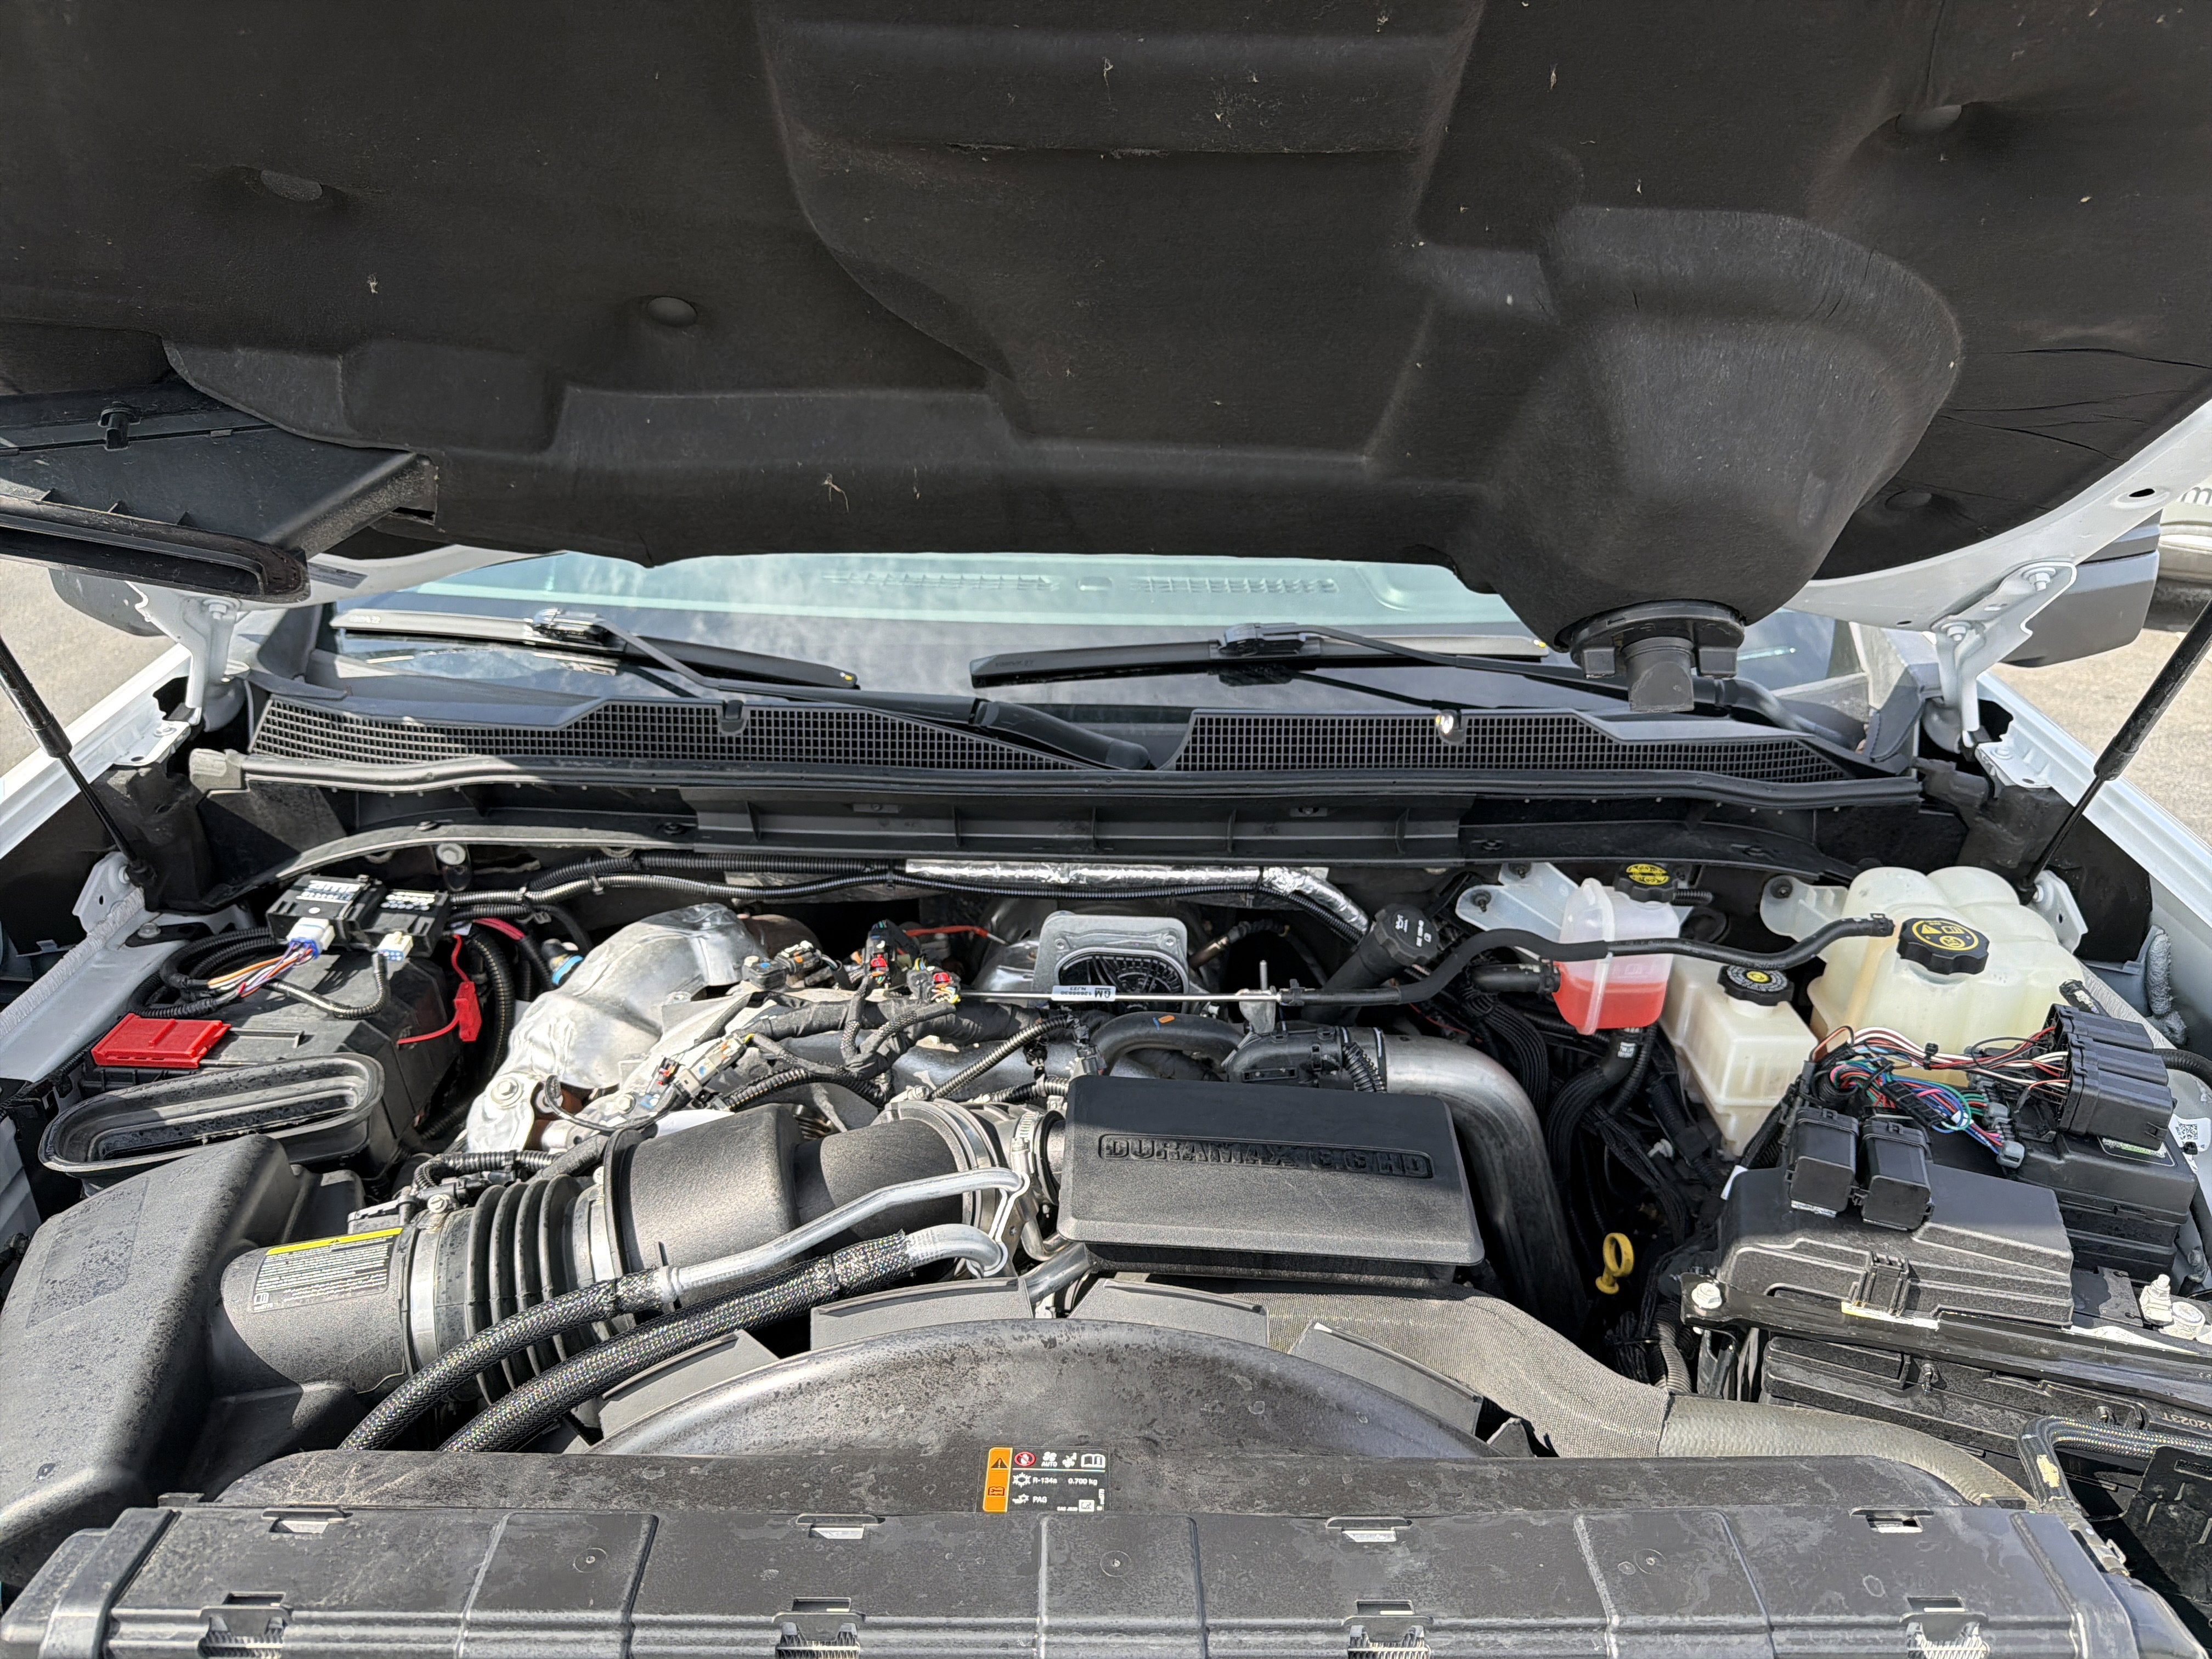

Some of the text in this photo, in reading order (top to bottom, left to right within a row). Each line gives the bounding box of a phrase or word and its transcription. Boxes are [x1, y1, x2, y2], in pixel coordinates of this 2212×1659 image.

[1094, 989, 1111, 998] GM
[1104, 1137, 1300, 1169] DURAMAX
[1088, 1478, 1098, 1486] kg
